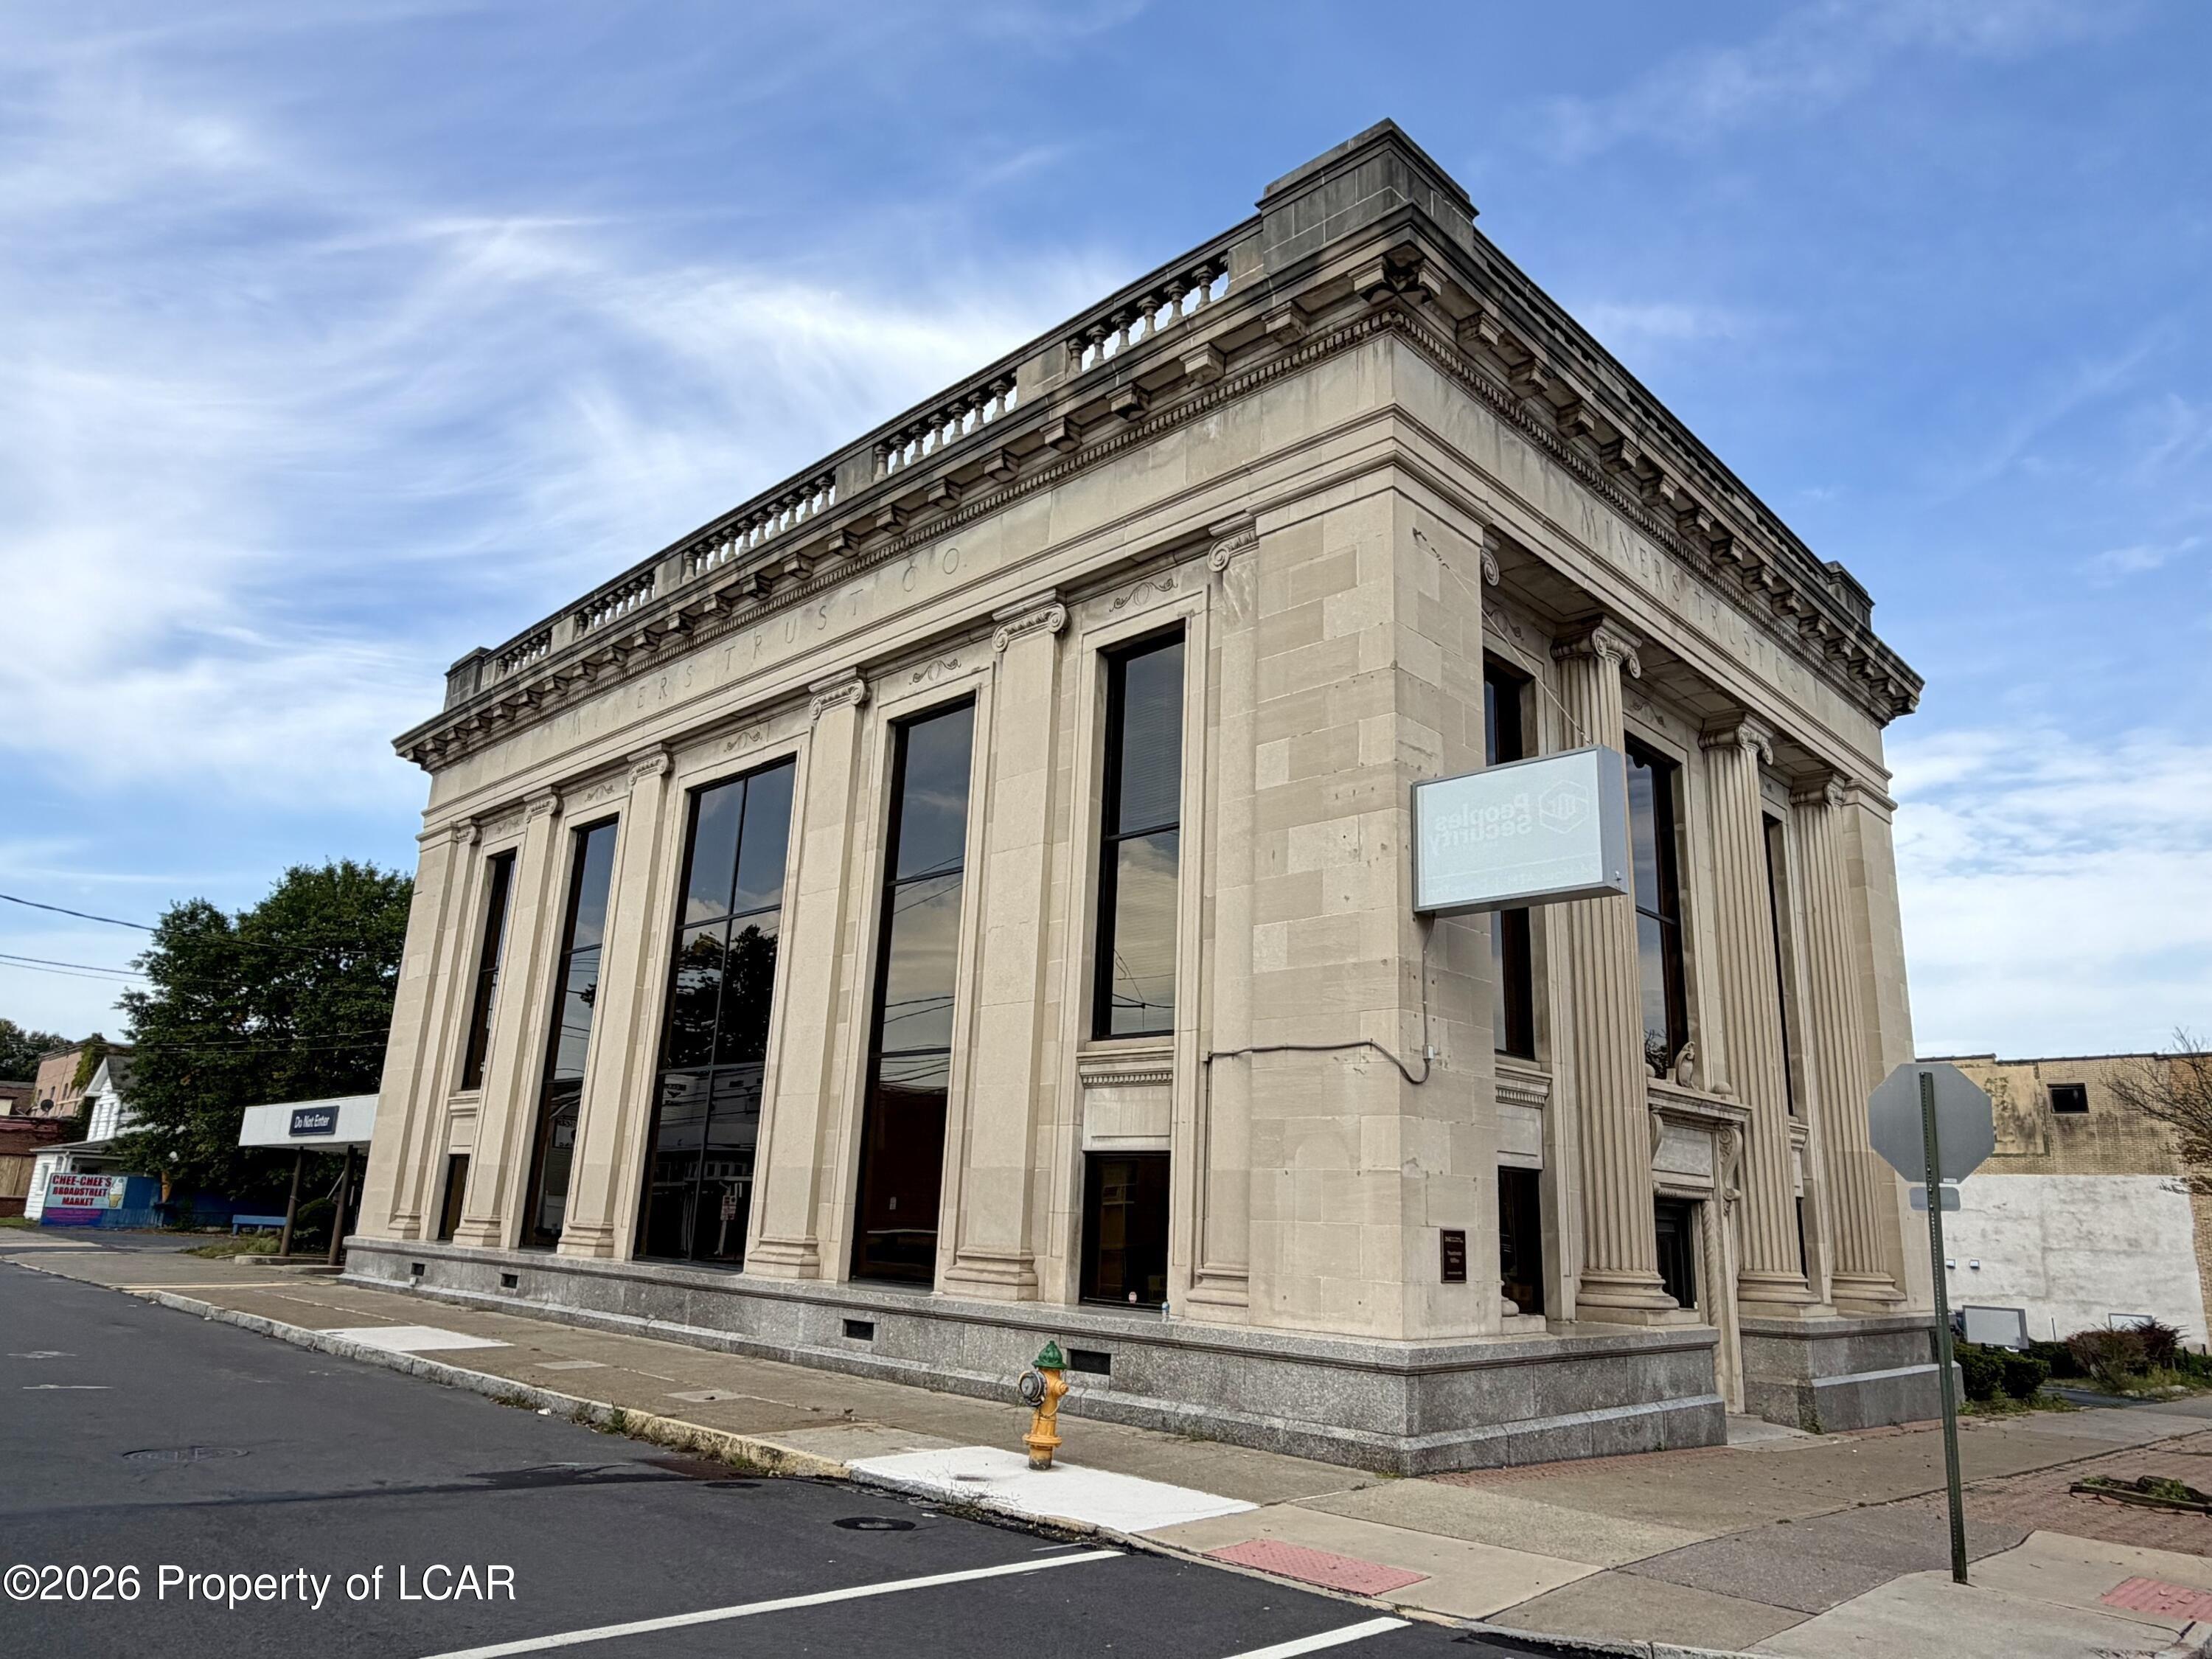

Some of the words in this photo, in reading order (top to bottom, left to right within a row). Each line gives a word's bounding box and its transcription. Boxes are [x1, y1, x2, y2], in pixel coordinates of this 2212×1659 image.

[1581, 501, 1681, 602] MINERS
[1694, 591, 1765, 669] TRUST
[724, 588, 864, 672] TRUST
[902, 548, 967, 592] CO.
[294, 1116, 302, 1128] Do
[303, 1115, 314, 1127] Not
[314, 1114, 330, 1127] Enter
[52, 1175, 113, 1187] CHEE-CHEE'S
[61, 1197, 95, 1206] MARKET
